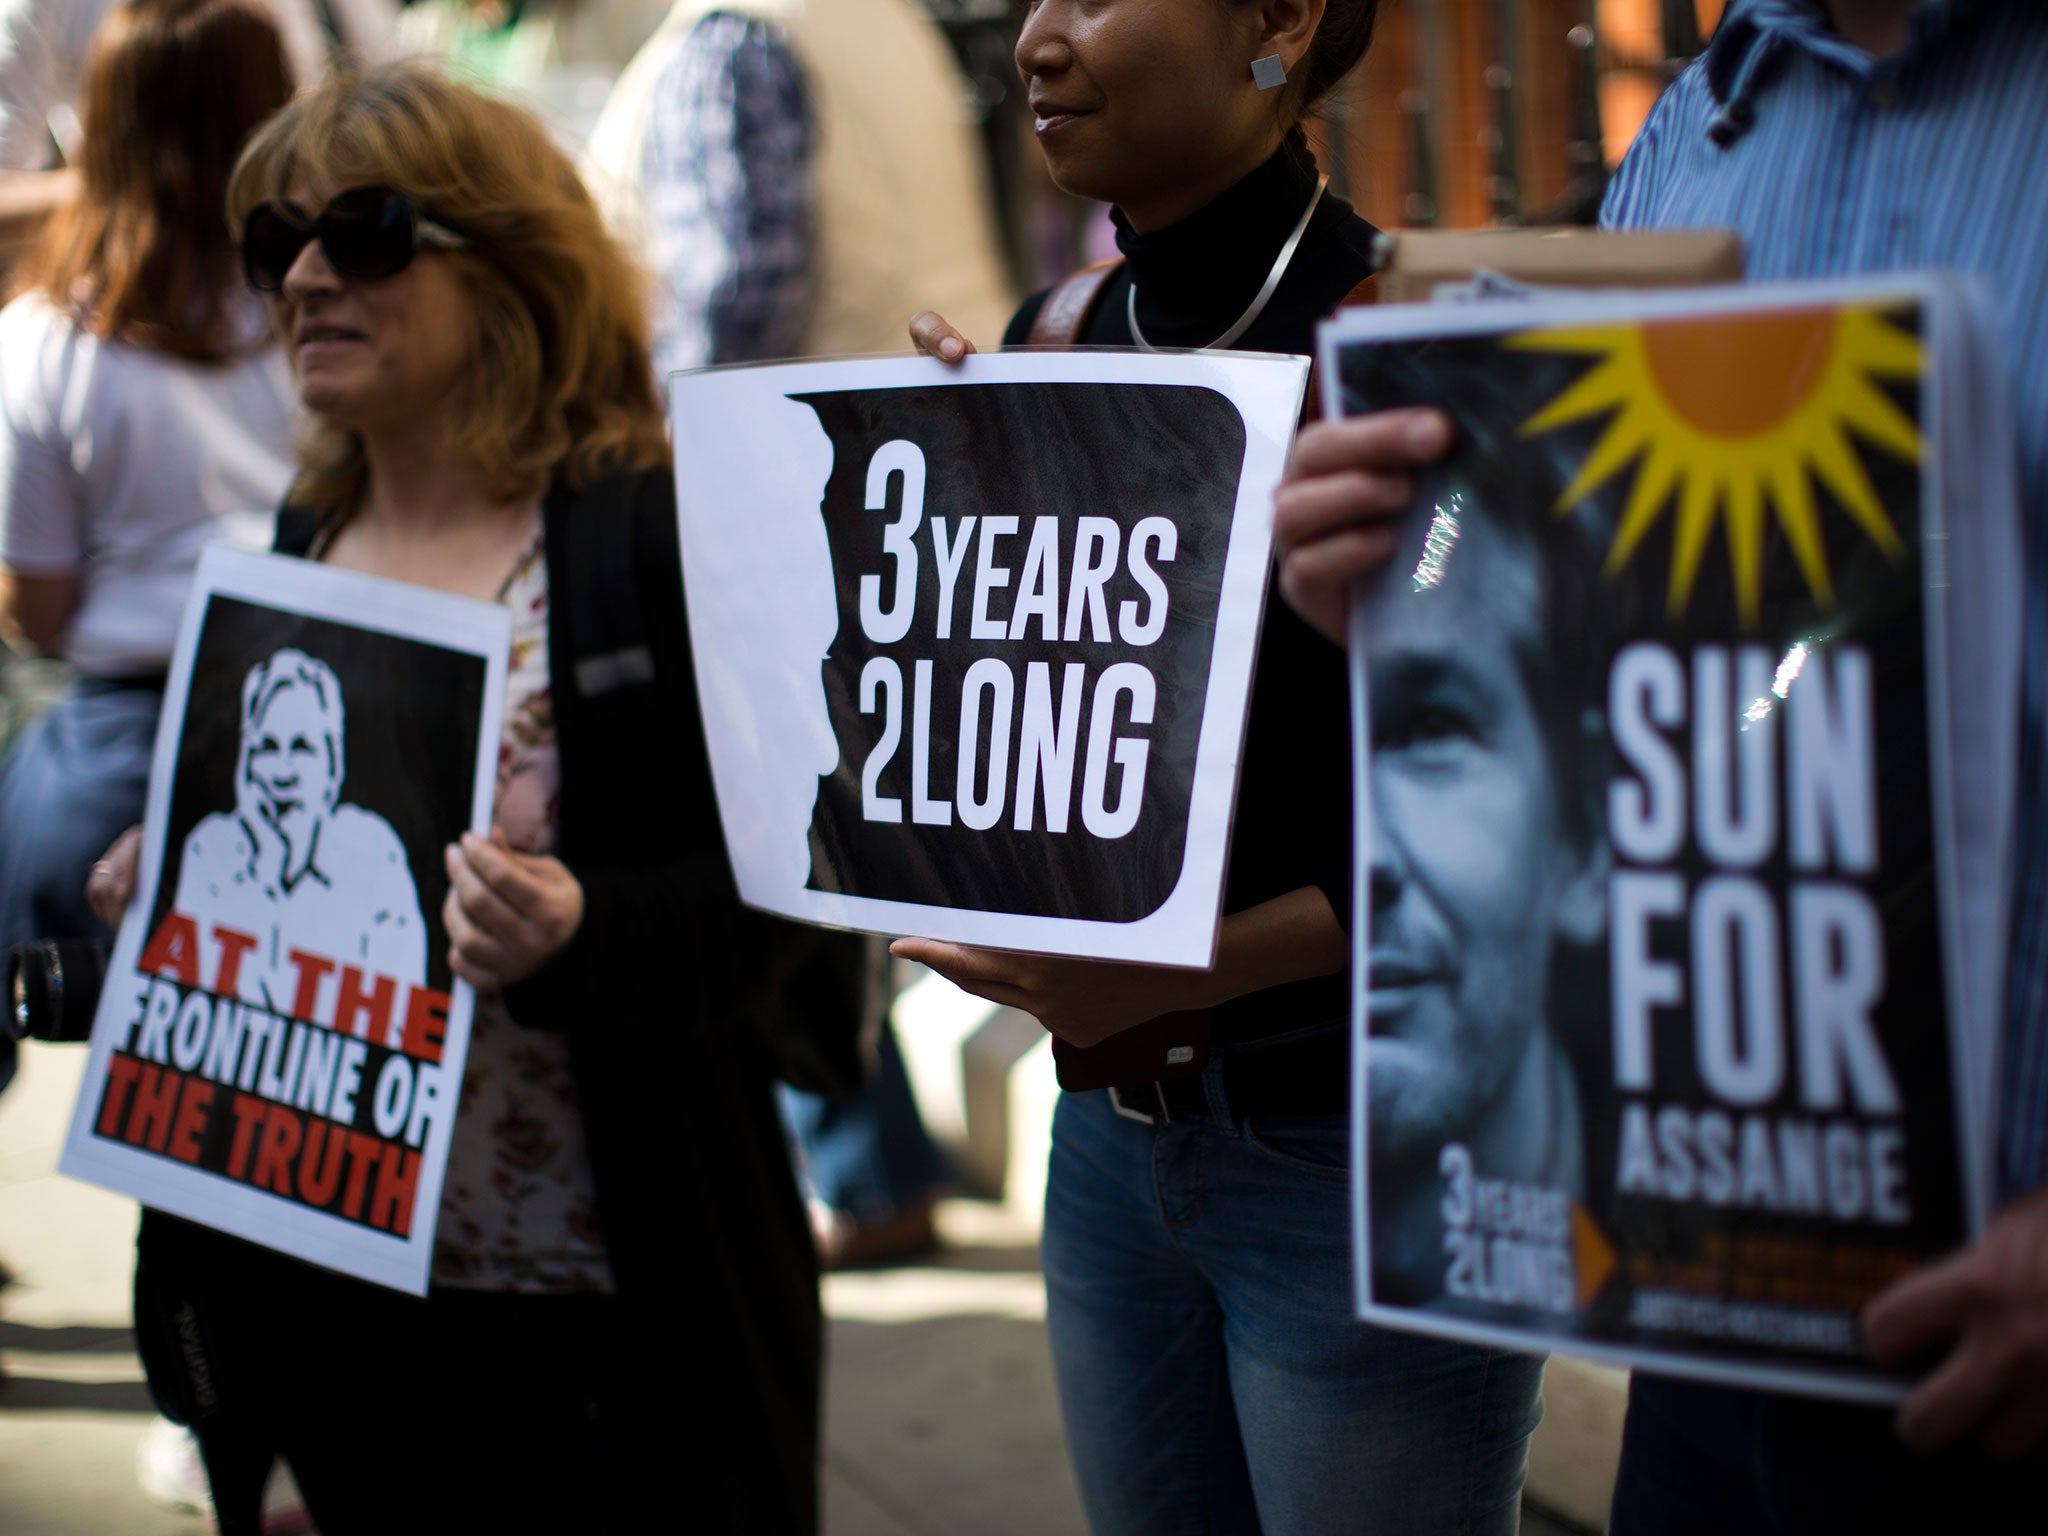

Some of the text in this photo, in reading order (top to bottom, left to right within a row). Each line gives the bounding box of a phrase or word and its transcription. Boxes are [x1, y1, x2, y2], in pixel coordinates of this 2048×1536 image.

[859, 656, 1158, 839] 2LONG
[1608, 640, 1878, 873] SUN
[120, 977, 443, 1148] FRONTLINE OF
[138, 910, 453, 1064] AT THE
[1610, 871, 1903, 1114] FOR
[97, 1052, 423, 1237] THE TRUTH
[1616, 1104, 1909, 1223] ASSANGE
